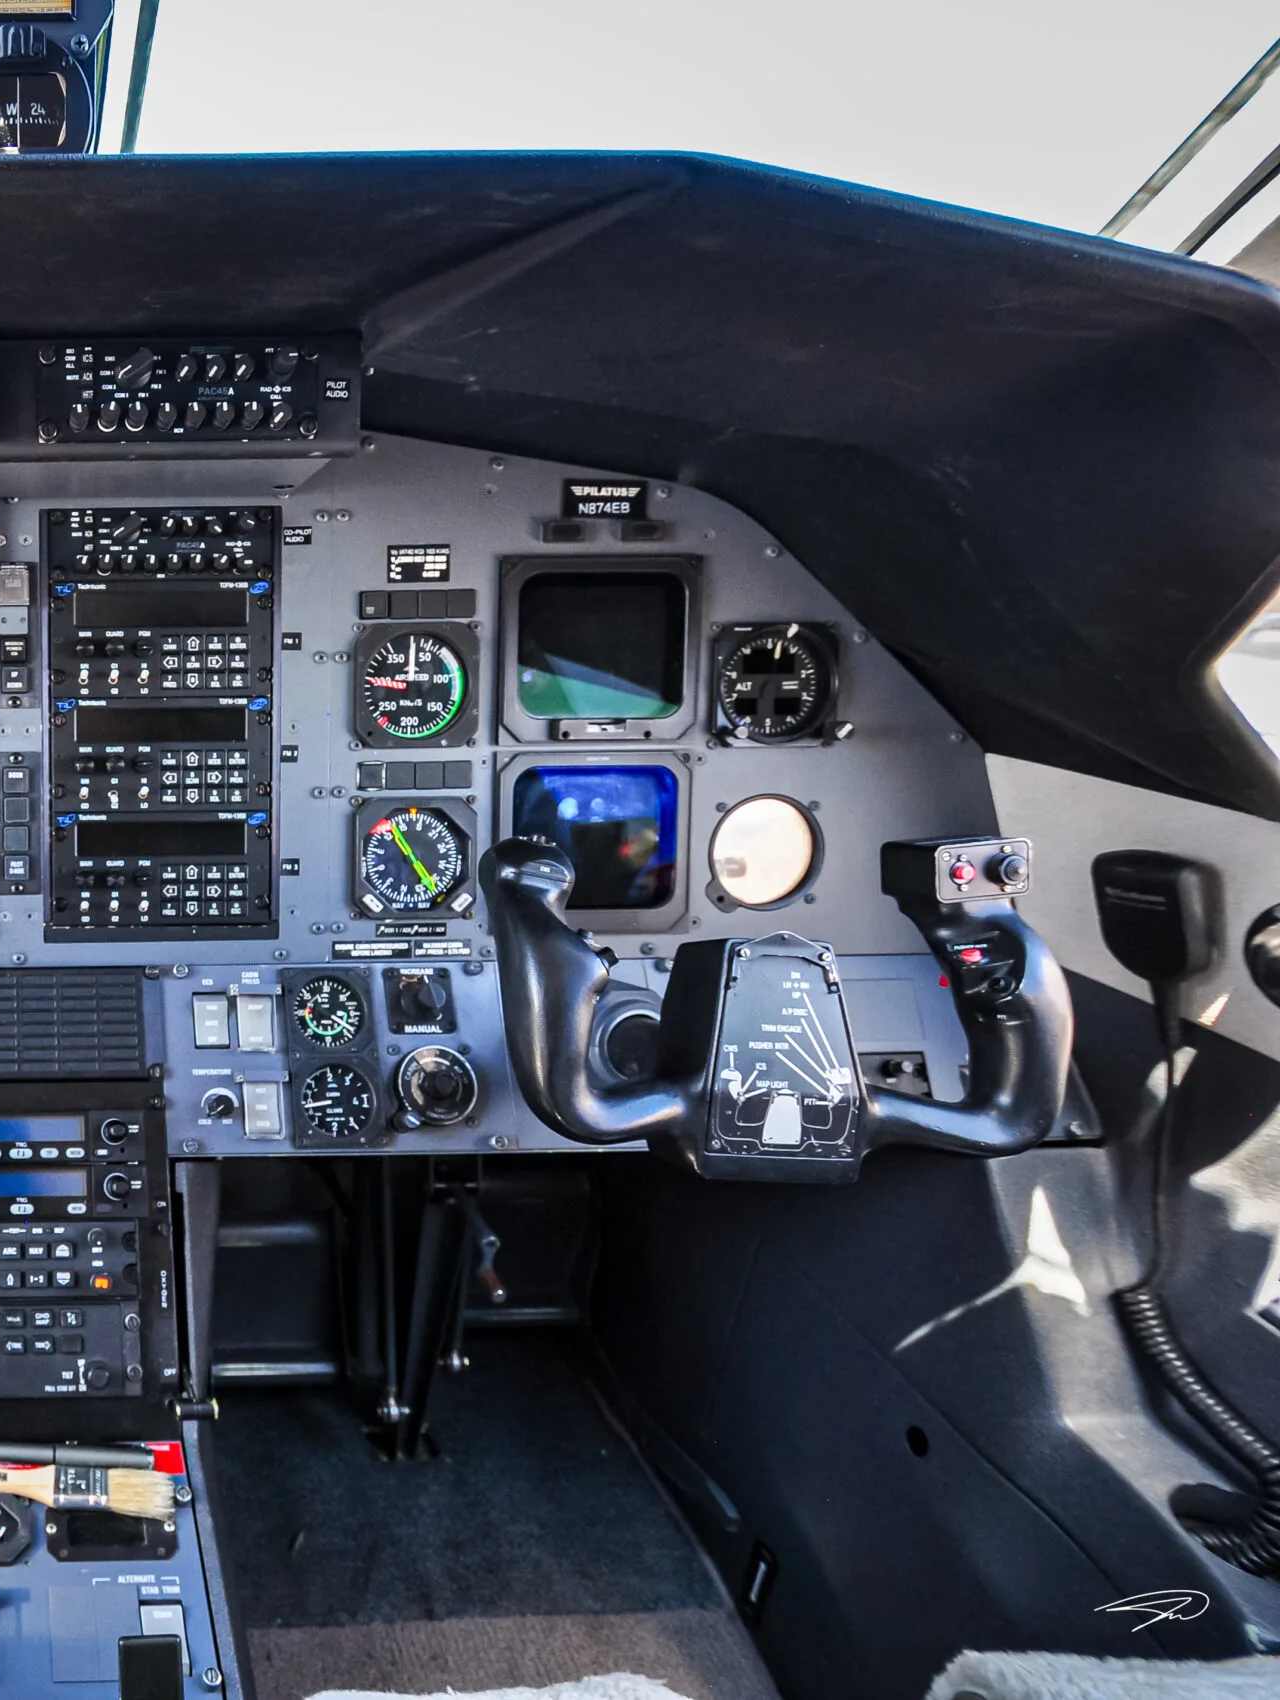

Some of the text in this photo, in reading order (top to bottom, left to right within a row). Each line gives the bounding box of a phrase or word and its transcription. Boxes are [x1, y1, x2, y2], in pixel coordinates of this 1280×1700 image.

[6, 104, 17, 115] W
[30, 103, 46, 115] 24
[327, 381, 346, 389] PILOT
[326, 390, 348, 398] AUDIO
[583, 487, 628, 497] PILATUS
[578, 502, 630, 514] N874EB
[386, 654, 405, 663] 350
[419, 652, 431, 661] 50
[433, 675, 448, 683] 100
[735, 682, 752, 691] ALT
[379, 702, 397, 710] 250
[427, 703, 442, 711] 150
[400, 717, 418, 725] 200
[777, 1025, 802, 1033] ENGAGE
